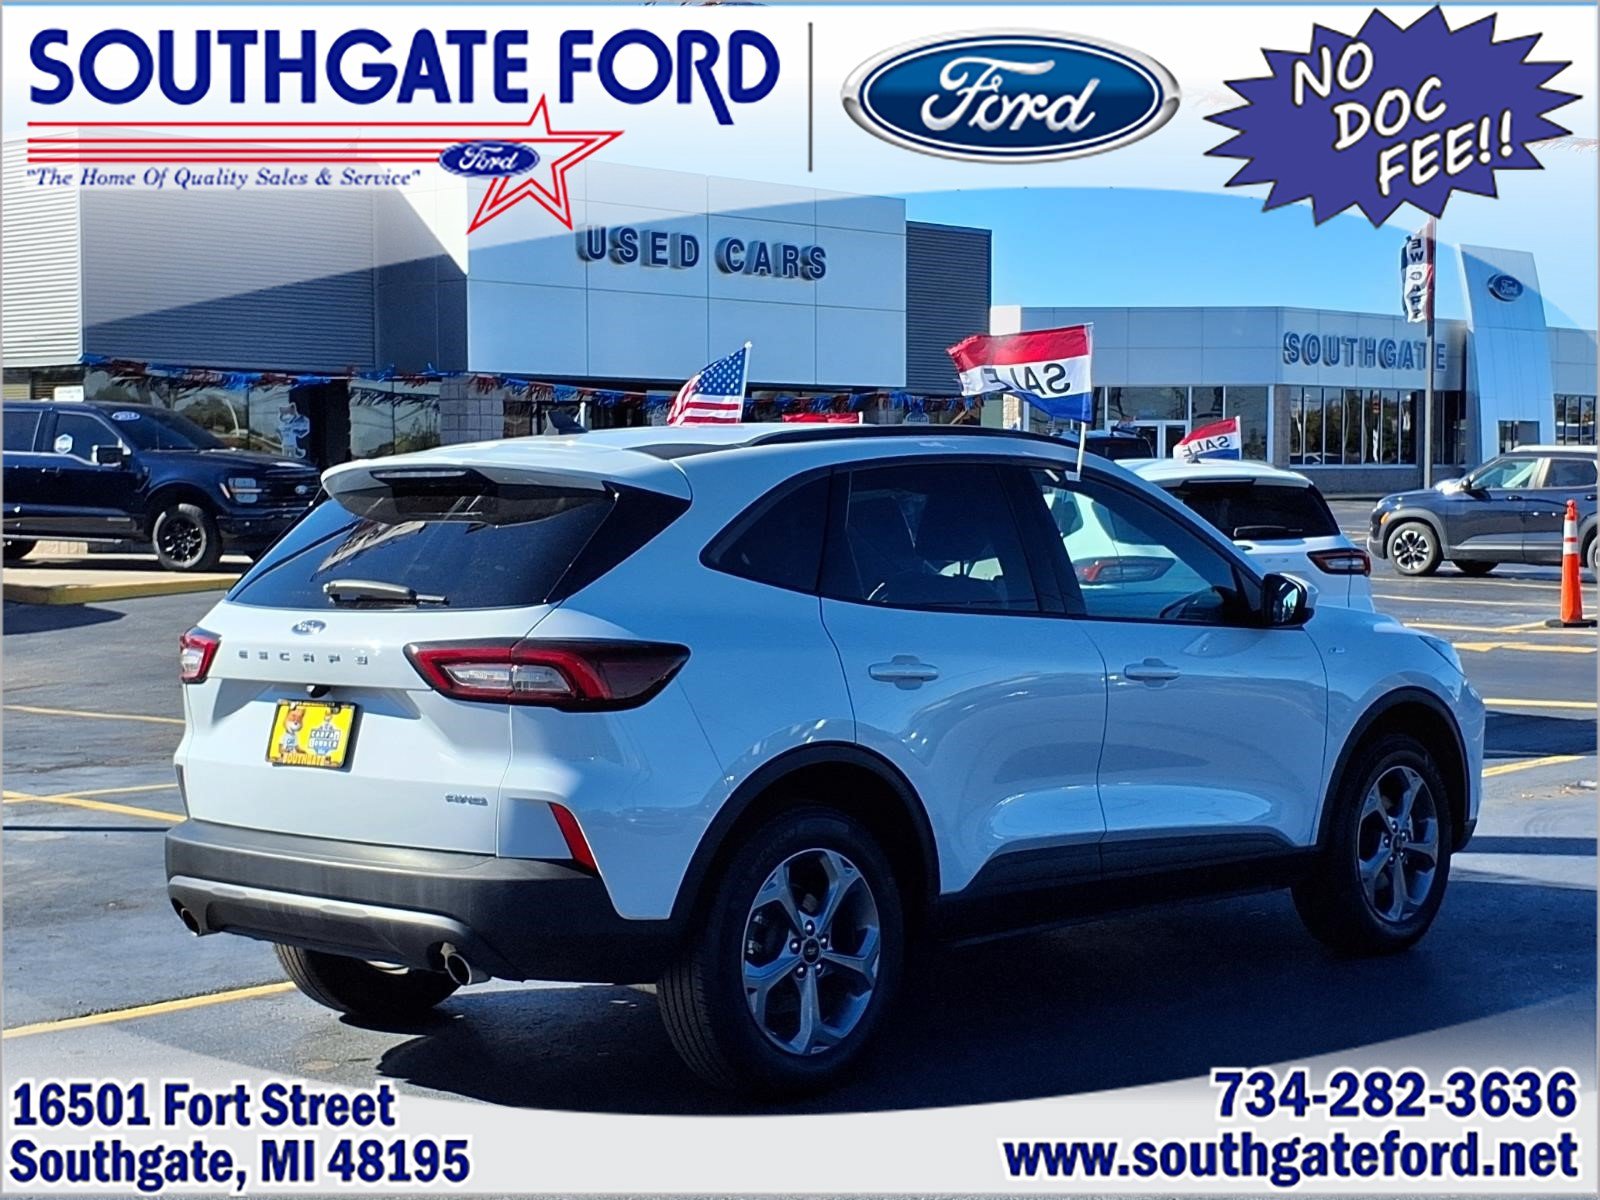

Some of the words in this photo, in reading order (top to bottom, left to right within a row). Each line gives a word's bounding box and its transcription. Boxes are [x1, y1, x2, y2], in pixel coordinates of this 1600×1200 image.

[579, 226, 700, 269] USED
[716, 236, 827, 282] CARS
[1284, 331, 1446, 371] SOUTHGATE
